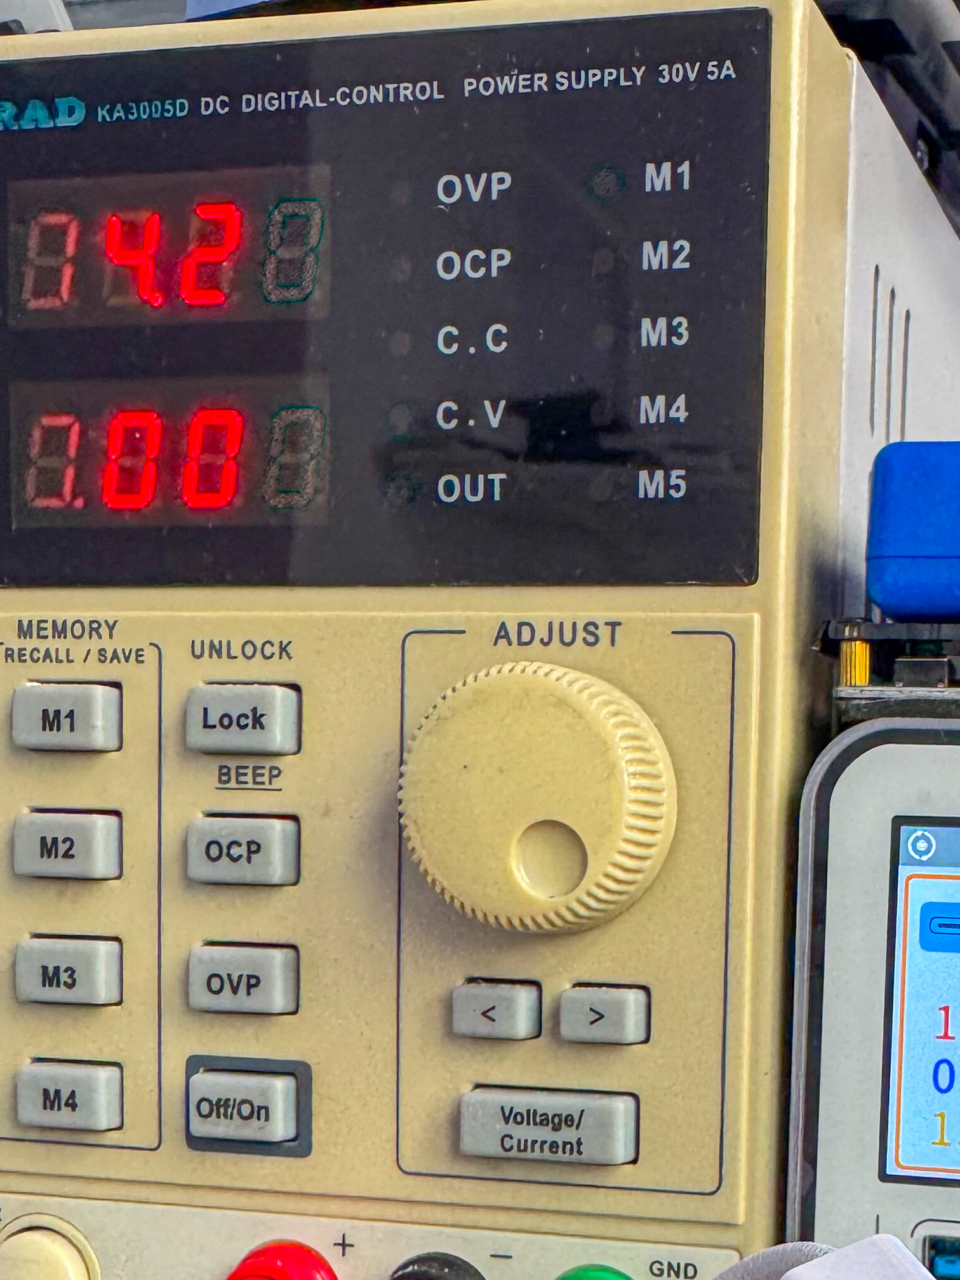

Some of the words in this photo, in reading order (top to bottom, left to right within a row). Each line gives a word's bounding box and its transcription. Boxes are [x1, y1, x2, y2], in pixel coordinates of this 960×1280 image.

[98, 98, 188, 122] KA3005D
[201, 96, 230, 115] DC
[242, 80, 444, 112] DIGITAL-CONTROL
[464, 72, 548, 97] POWER
[555, 66, 645, 91] SUPPLY
[658, 62, 700, 84] 30V
[707, 59, 736, 81] 5A
[437, 172, 511, 204] OVP
[645, 160, 691, 192] M1
[436, 249, 511, 280] OCP
[642, 240, 691, 271] M2
[437, 324, 508, 354] C.C
[641, 316, 689, 347] M3
[436, 400, 506, 430] C.V
[639, 394, 689, 424] M4
[437, 473, 507, 503] OUT
[638, 469, 687, 499] M5
[17, 619, 118, 640] MEMORY
[493, 620, 622, 647] ADJUST
[5, 647, 74, 664] RECALL
[97, 648, 145, 664] SAVE
[191, 639, 293, 661] UNLOCK
[41, 709, 76, 733] M1
[202, 707, 267, 731] Lock
[217, 765, 283, 787] BEEP
[39, 836, 76, 860] M2
[204, 839, 262, 864] OCP
[41, 965, 77, 989] M3
[206, 973, 262, 997] OVP
[42, 1088, 78, 1112] M4
[195, 1096, 271, 1122] Off/On
[500, 1105, 585, 1132] Voltage/
[500, 1133, 584, 1156] Current
[649, 1259, 698, 1280] GND
